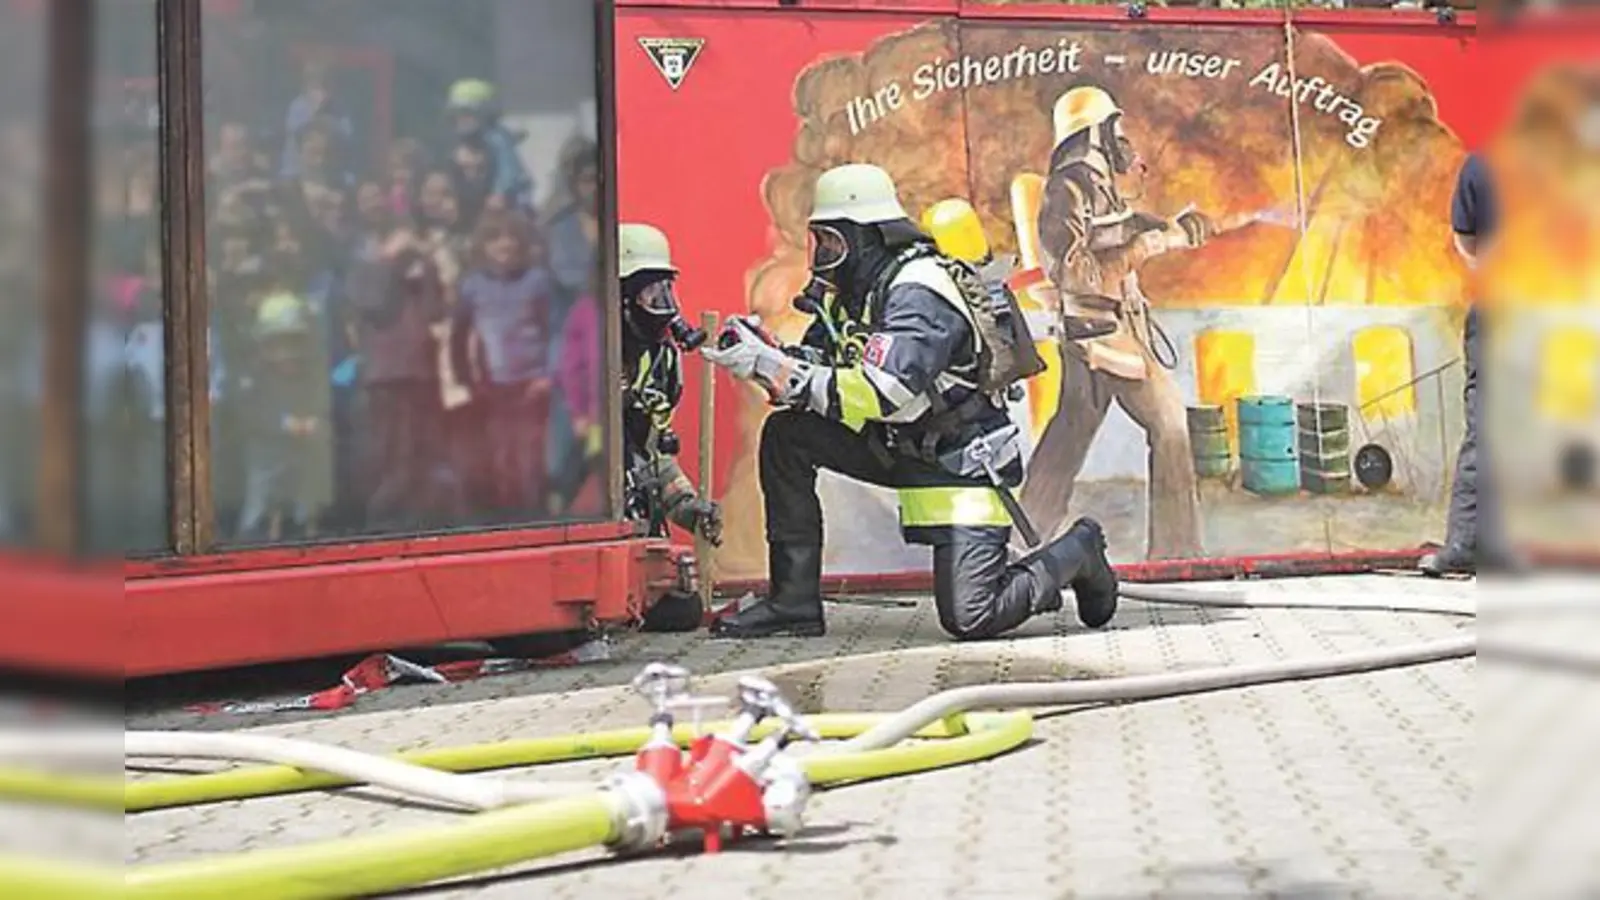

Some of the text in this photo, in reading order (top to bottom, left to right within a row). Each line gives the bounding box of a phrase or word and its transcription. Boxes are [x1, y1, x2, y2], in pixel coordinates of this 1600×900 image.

[847, 83, 903, 135] Ihre
[912, 38, 1082, 101] Sicherheit
[1146, 50, 1241, 80] unser
[1249, 62, 1382, 148] Auftrag
